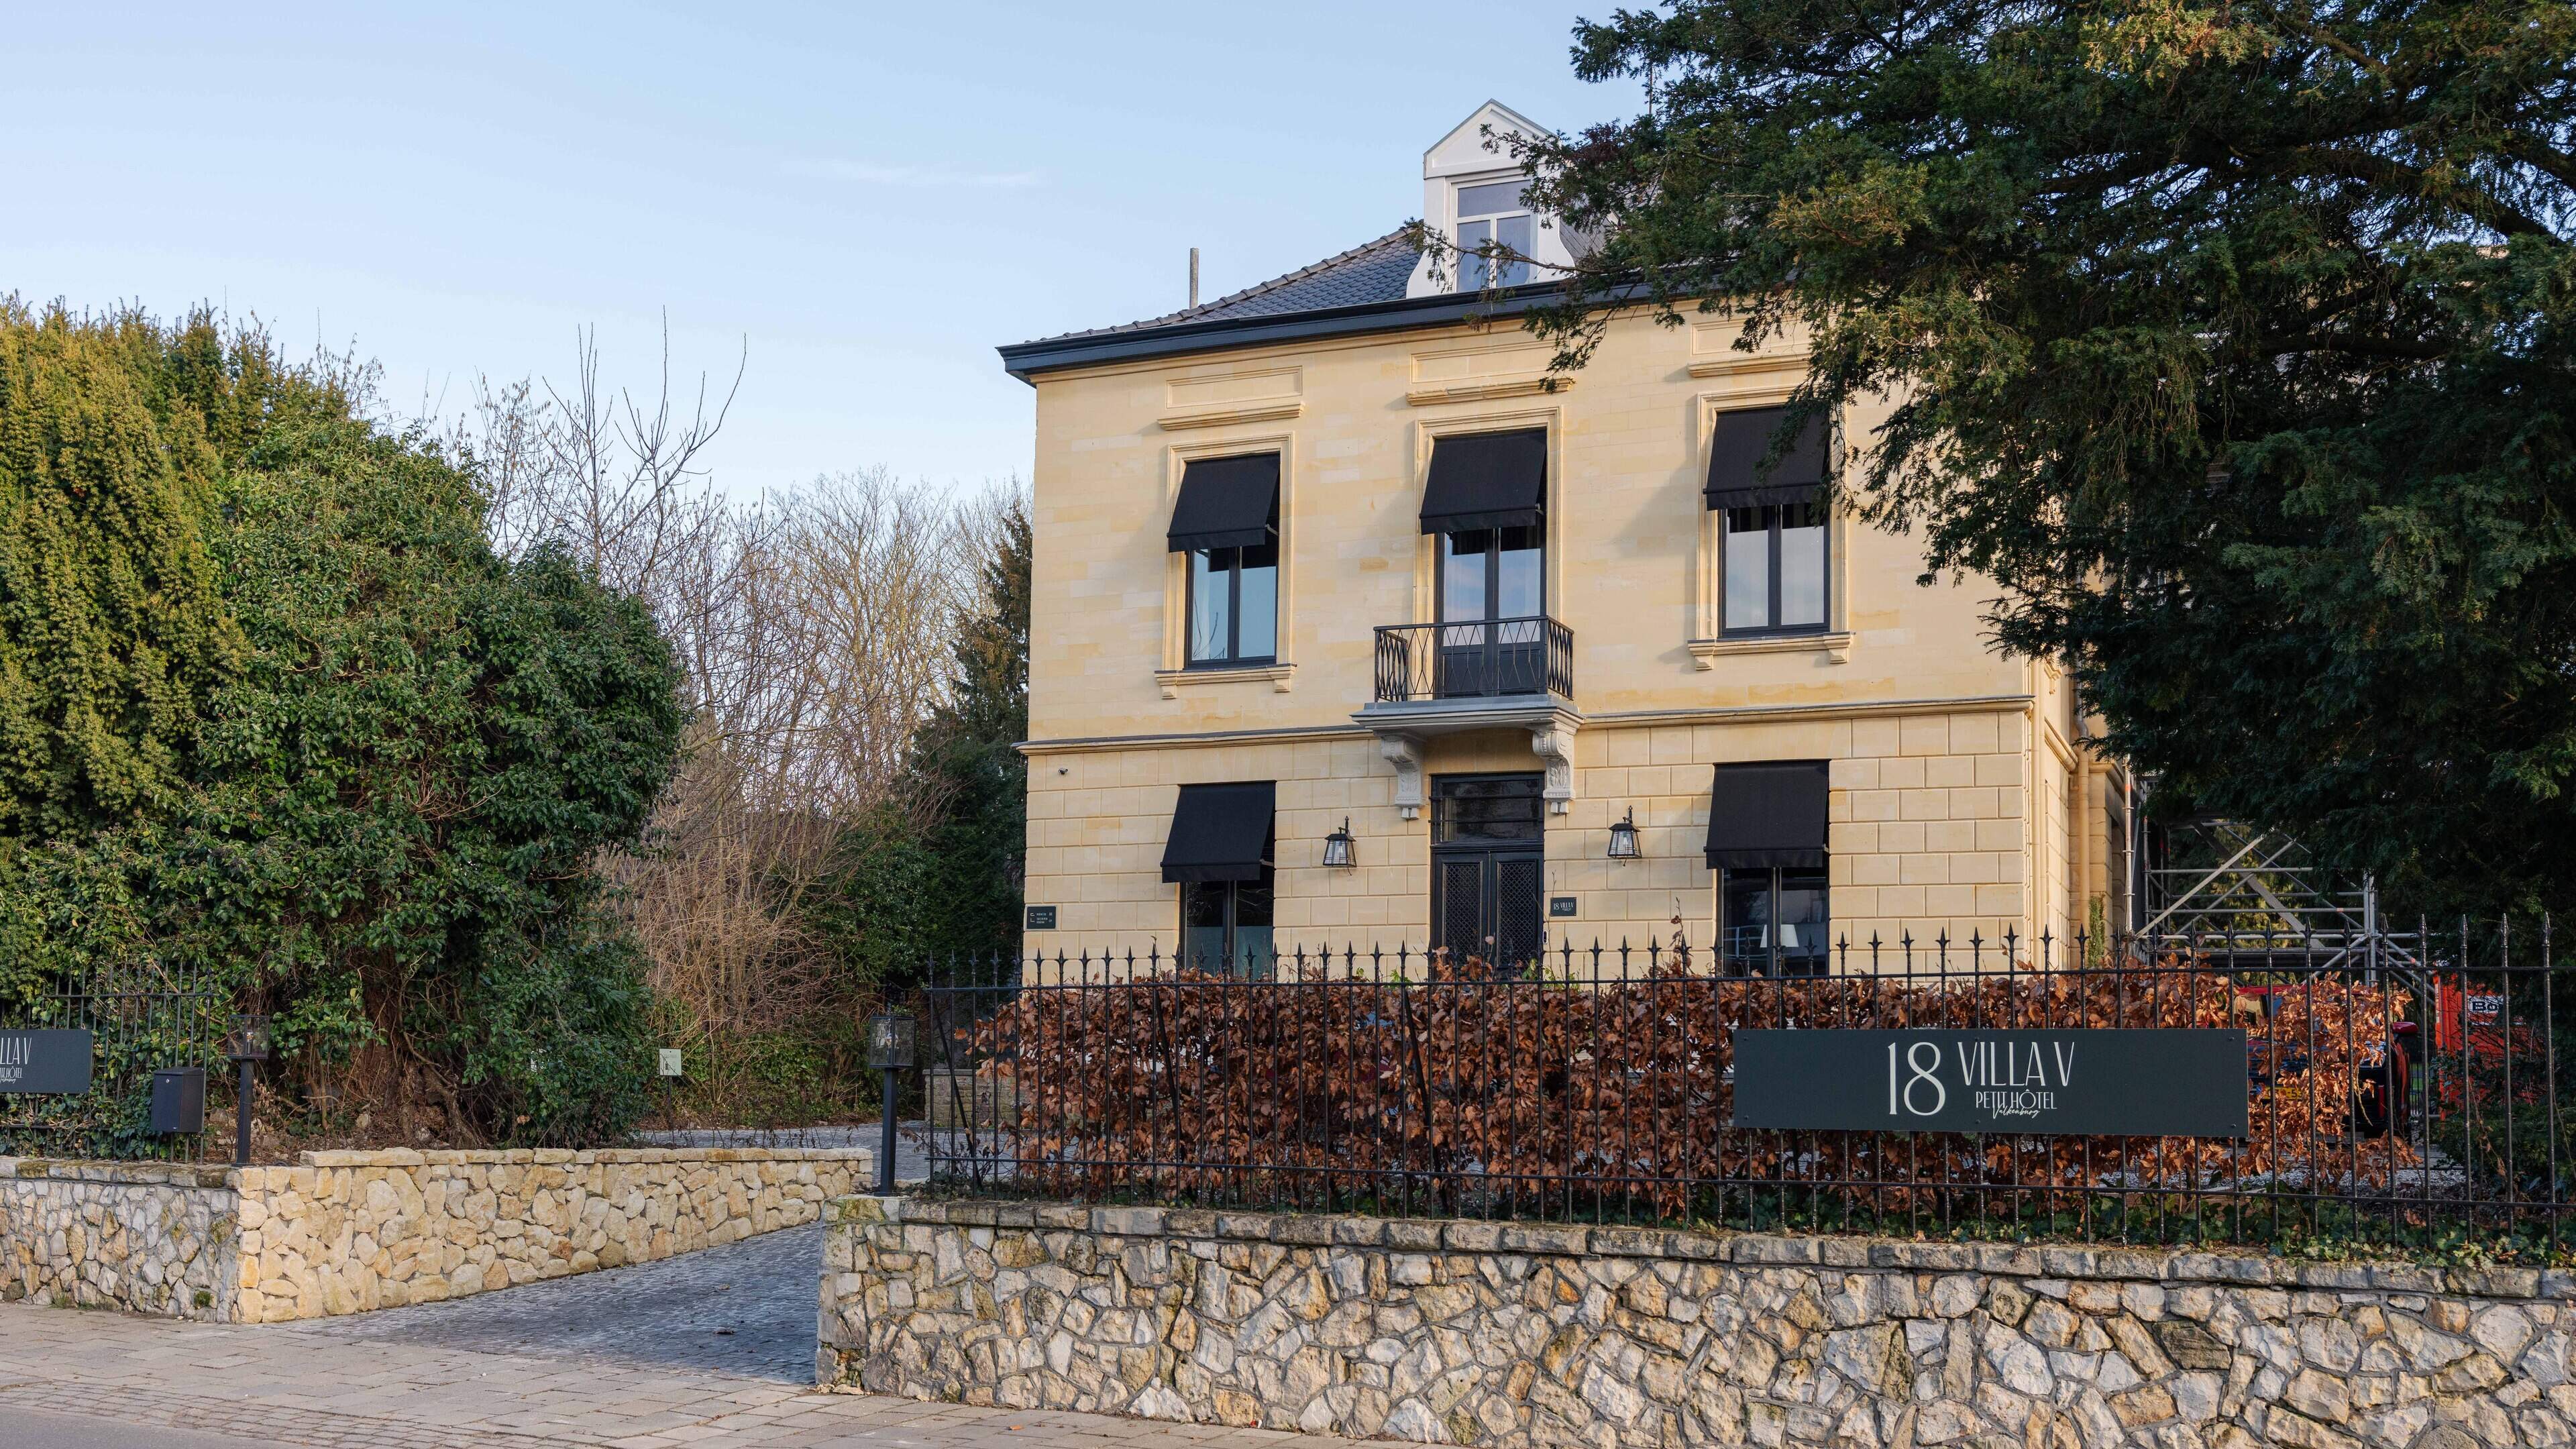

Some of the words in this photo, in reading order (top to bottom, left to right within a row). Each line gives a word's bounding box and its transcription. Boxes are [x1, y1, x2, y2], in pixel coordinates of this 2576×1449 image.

[0, 1037, 19, 1065] LLA
[23, 1036, 32, 1065] V
[1888, 1042, 1945, 1116] 18
[1957, 1041, 2046, 1087] VILLA
[2054, 1041, 2075, 1087] V
[1975, 1091, 2008, 1109] PETIT
[2010, 1088, 2057, 1110] HÔTEL
[1992, 1103, 2040, 1120] Valkenburg
